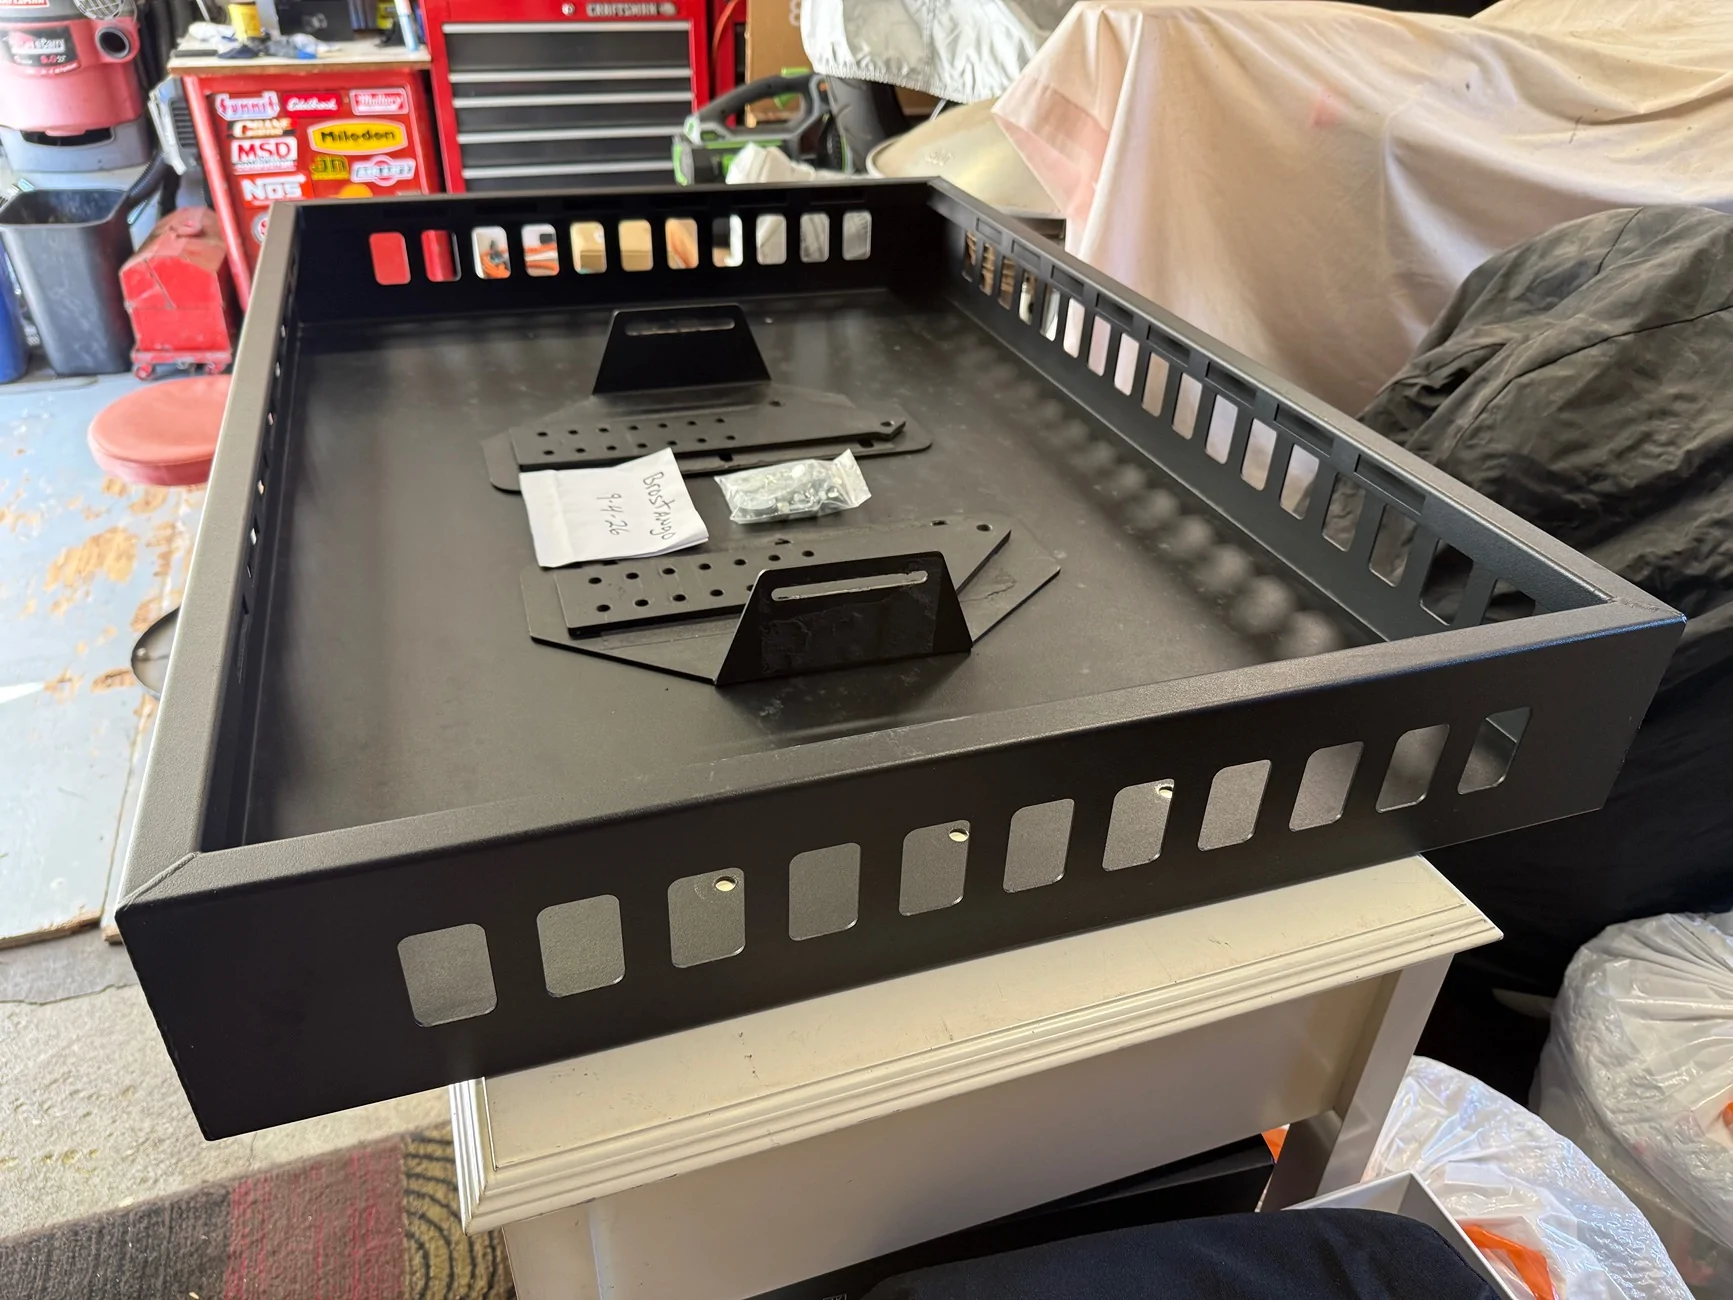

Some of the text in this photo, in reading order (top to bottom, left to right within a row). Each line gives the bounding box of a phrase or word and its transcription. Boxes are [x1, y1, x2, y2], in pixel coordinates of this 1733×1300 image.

[220, 94, 277, 115] SUMMIT
[238, 142, 290, 160] MSD
[241, 174, 306, 200] NOS
